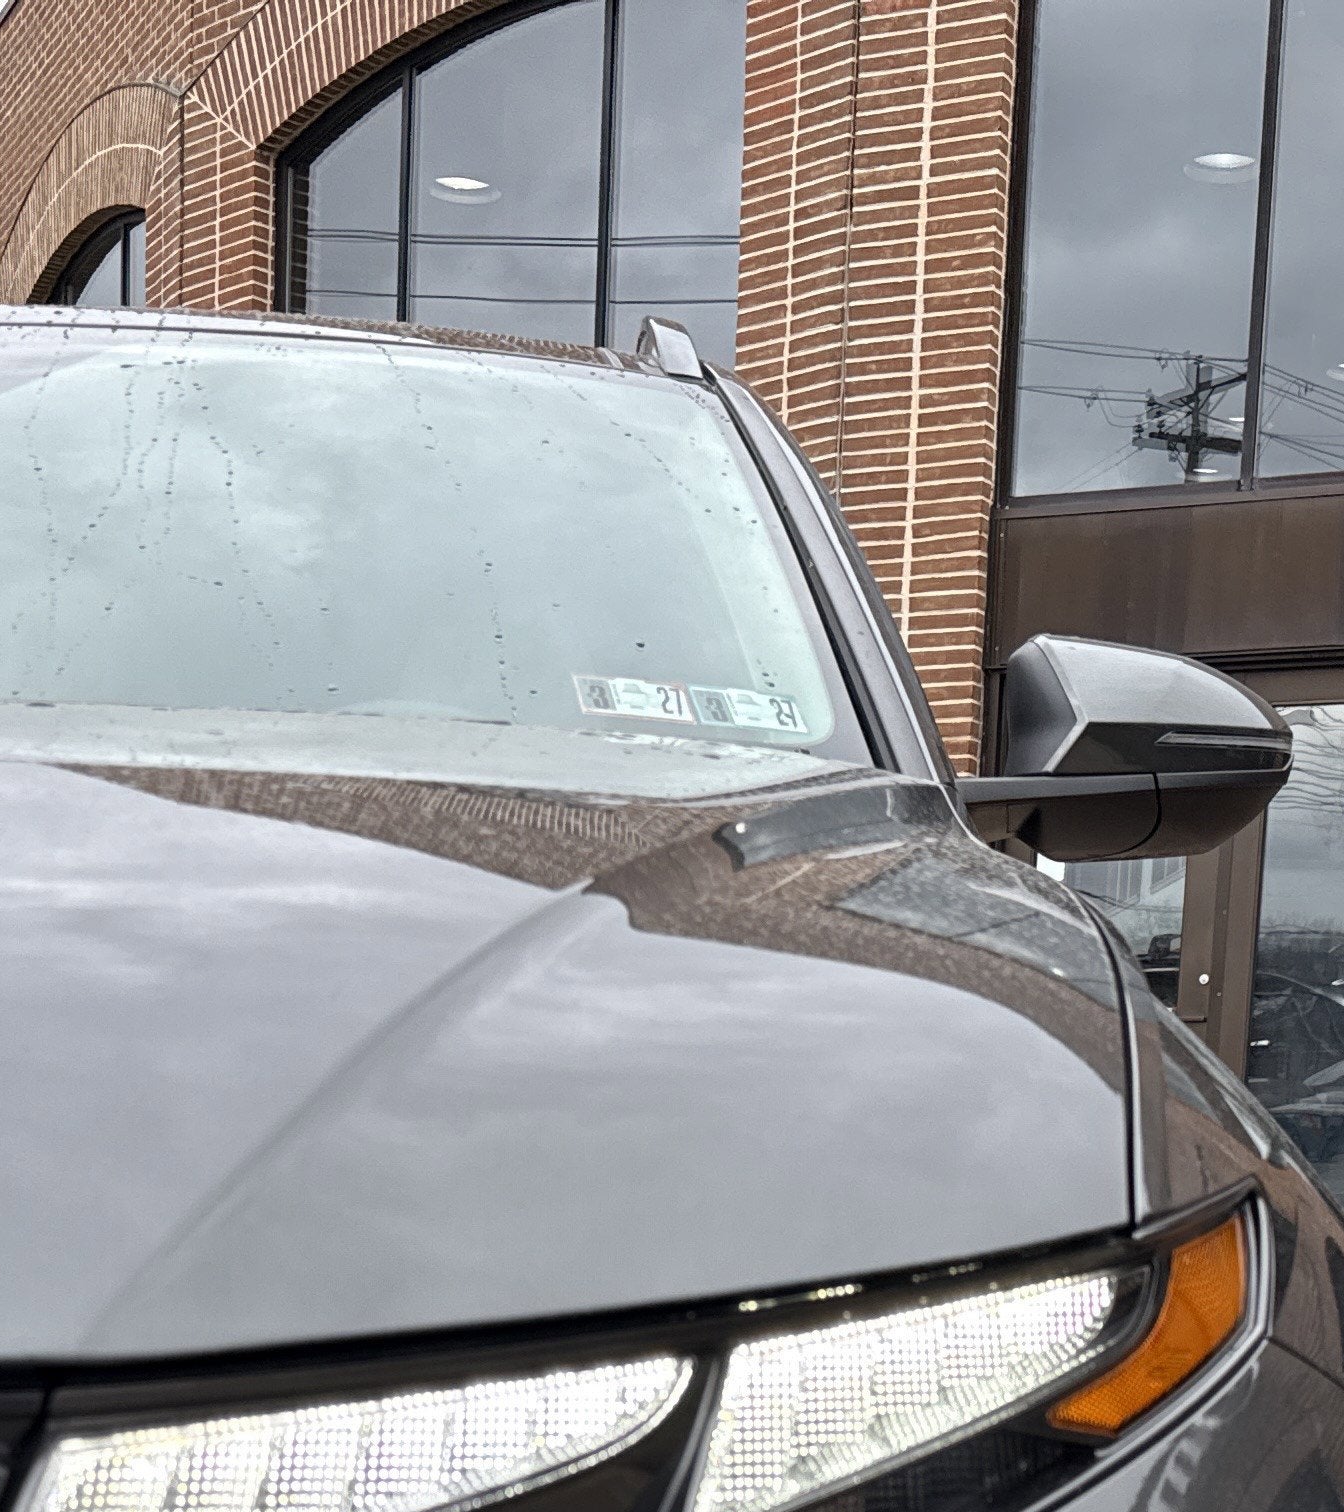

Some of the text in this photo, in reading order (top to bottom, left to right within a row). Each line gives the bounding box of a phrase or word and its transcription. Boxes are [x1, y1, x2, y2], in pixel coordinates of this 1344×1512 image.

[588, 685, 610, 709] 3
[656, 686, 683, 716] 27
[705, 697, 728, 722] 3
